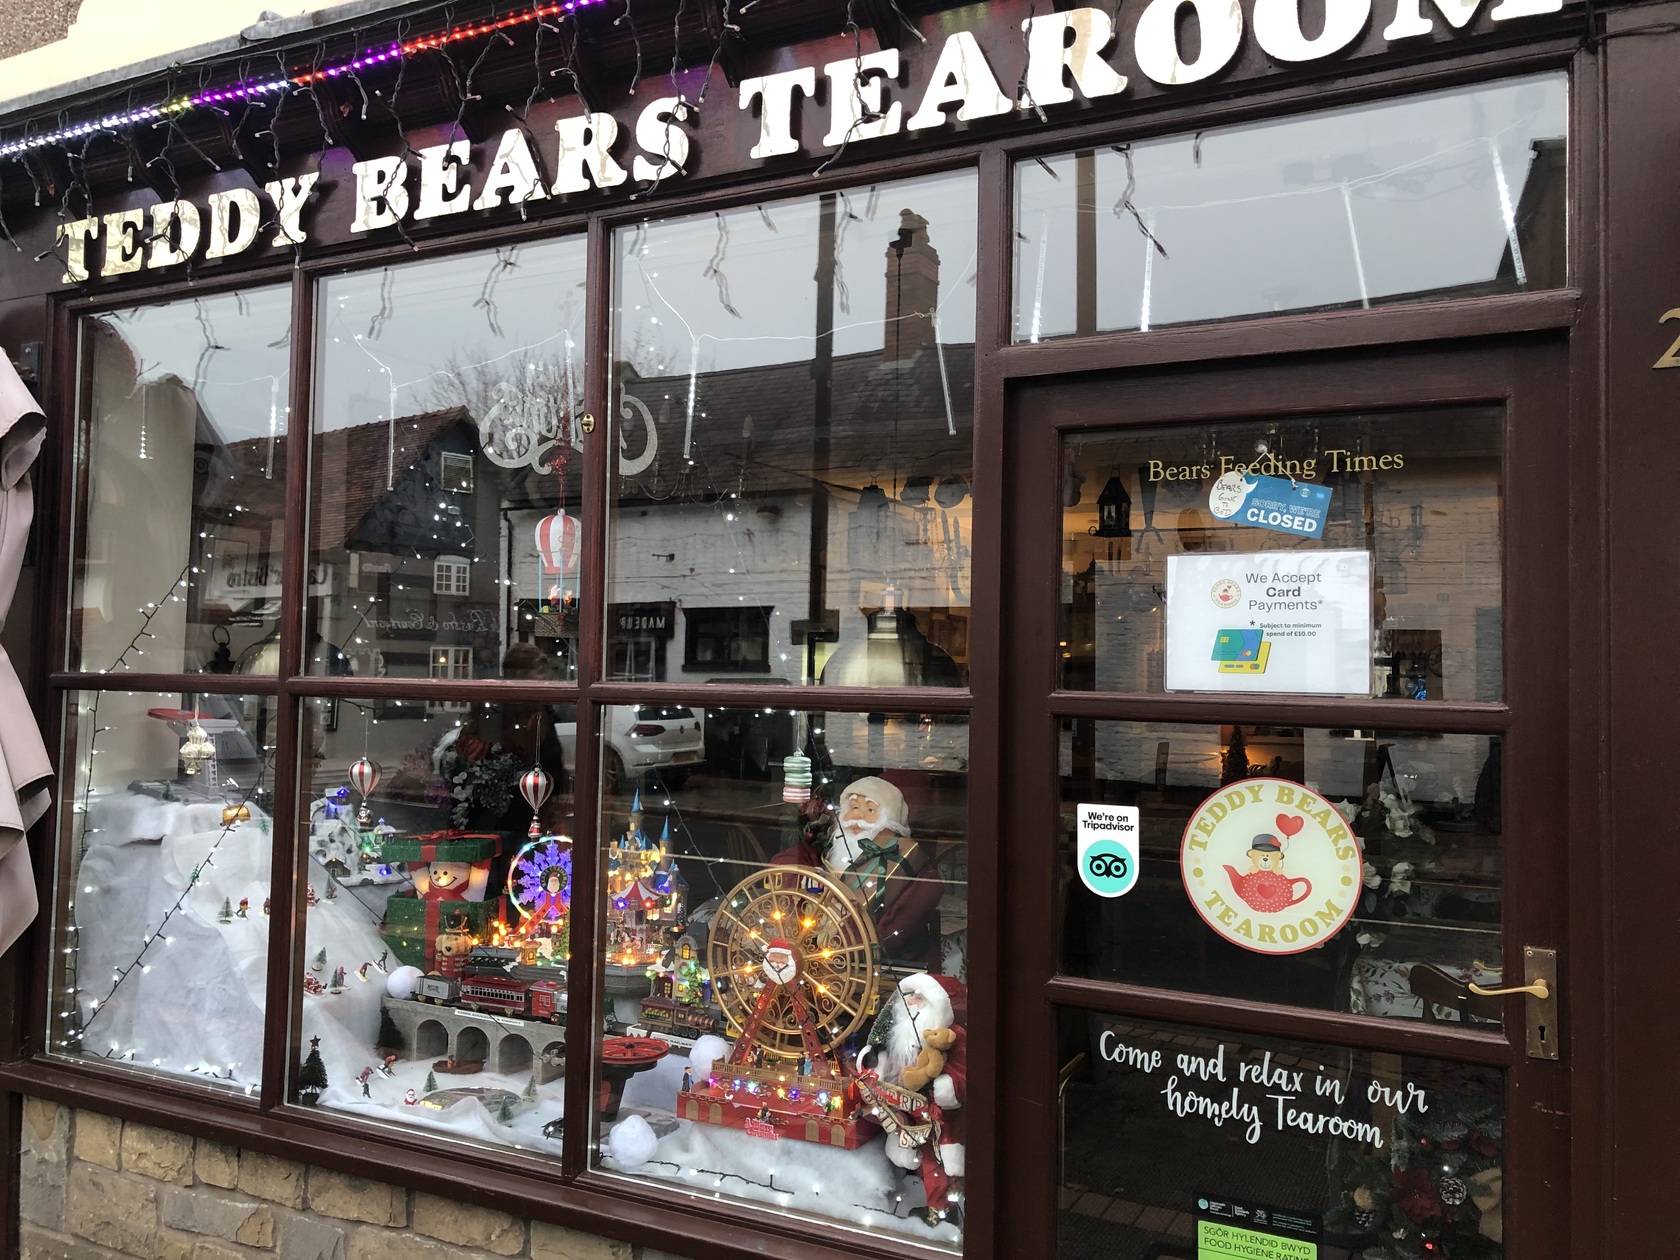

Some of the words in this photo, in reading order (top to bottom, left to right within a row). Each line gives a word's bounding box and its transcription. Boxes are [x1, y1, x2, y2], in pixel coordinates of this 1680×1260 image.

[56, 173, 320, 284] TEDDY
[350, 94, 690, 233] BEARS
[1148, 460, 1211, 481] Bears
[1219, 452, 1317, 479] Feeding
[1325, 450, 1405, 473] Times
[1246, 508, 1318, 532] CLOSED
[1251, 498, 1287, 513] SORRY,
[1289, 504, 1322, 518] WE'RE
[1245, 573, 1268, 583] We
[1271, 573, 1322, 585] Accept
[1266, 586, 1301, 597] Card
[1260, 622, 1284, 630] Subject
[1082, 820, 1134, 831] Tripadvisor
[1088, 811, 1114, 821] We're
[1188, 784, 1264, 852] TEDDY
[1275, 785, 1357, 861] BEARS
[1204, 890, 1344, 944] TEAROOM
[1100, 1030, 1162, 1073] Come
[1177, 1044, 1227, 1083] and
[1239, 1051, 1304, 1093] relax
[1315, 1065, 1345, 1106] in
[1367, 1080, 1429, 1114] our
[1160, 1076, 1263, 1144] homely
[1266, 1094, 1384, 1149] Tearoom
[1203, 1226, 1230, 1239] SGÔR
[1231, 1231, 1279, 1249] HYLENDID
[1281, 1242, 1311, 1255] BWYD
[1203, 1237, 1233, 1250] FOOD
[1234, 1243, 1274, 1260] HYGIENE
